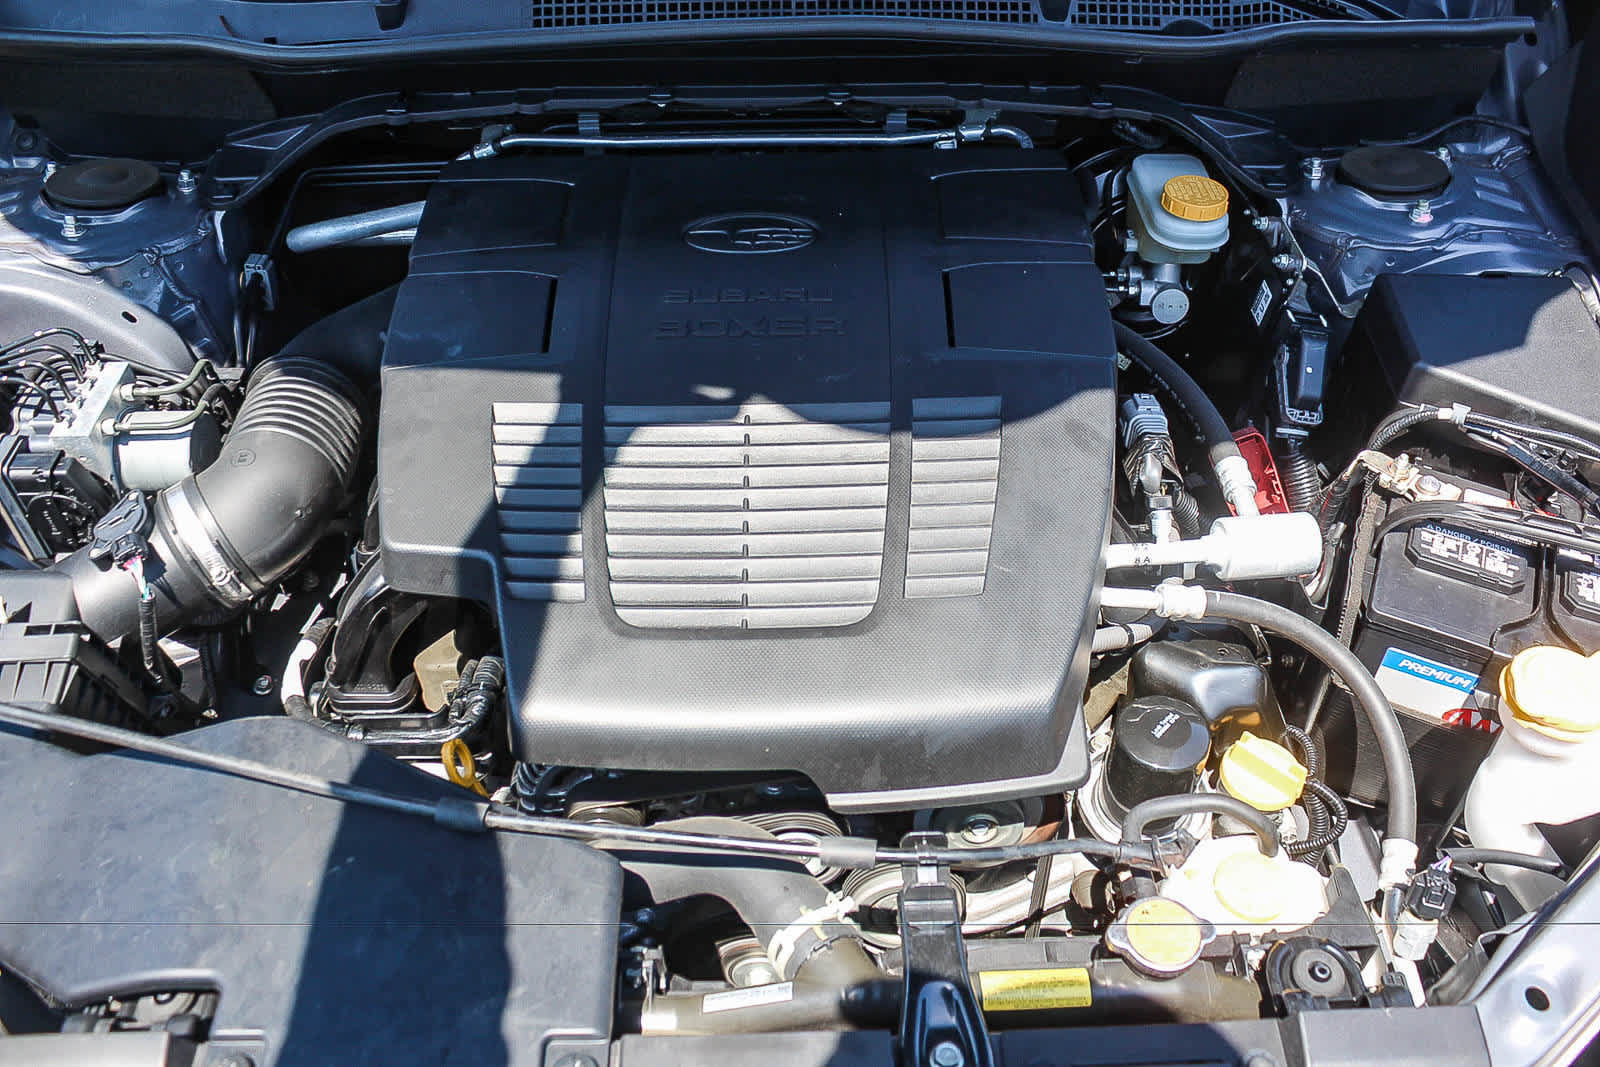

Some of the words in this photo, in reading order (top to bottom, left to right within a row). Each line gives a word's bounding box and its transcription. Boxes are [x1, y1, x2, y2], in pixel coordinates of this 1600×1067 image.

[663, 287, 833, 304] SUBARU
[655, 316, 847, 338] BOXER
[1435, 526, 1472, 542] DANGER
[1480, 539, 1513, 554] POISON
[1398, 658, 1472, 688] PREMIUM
